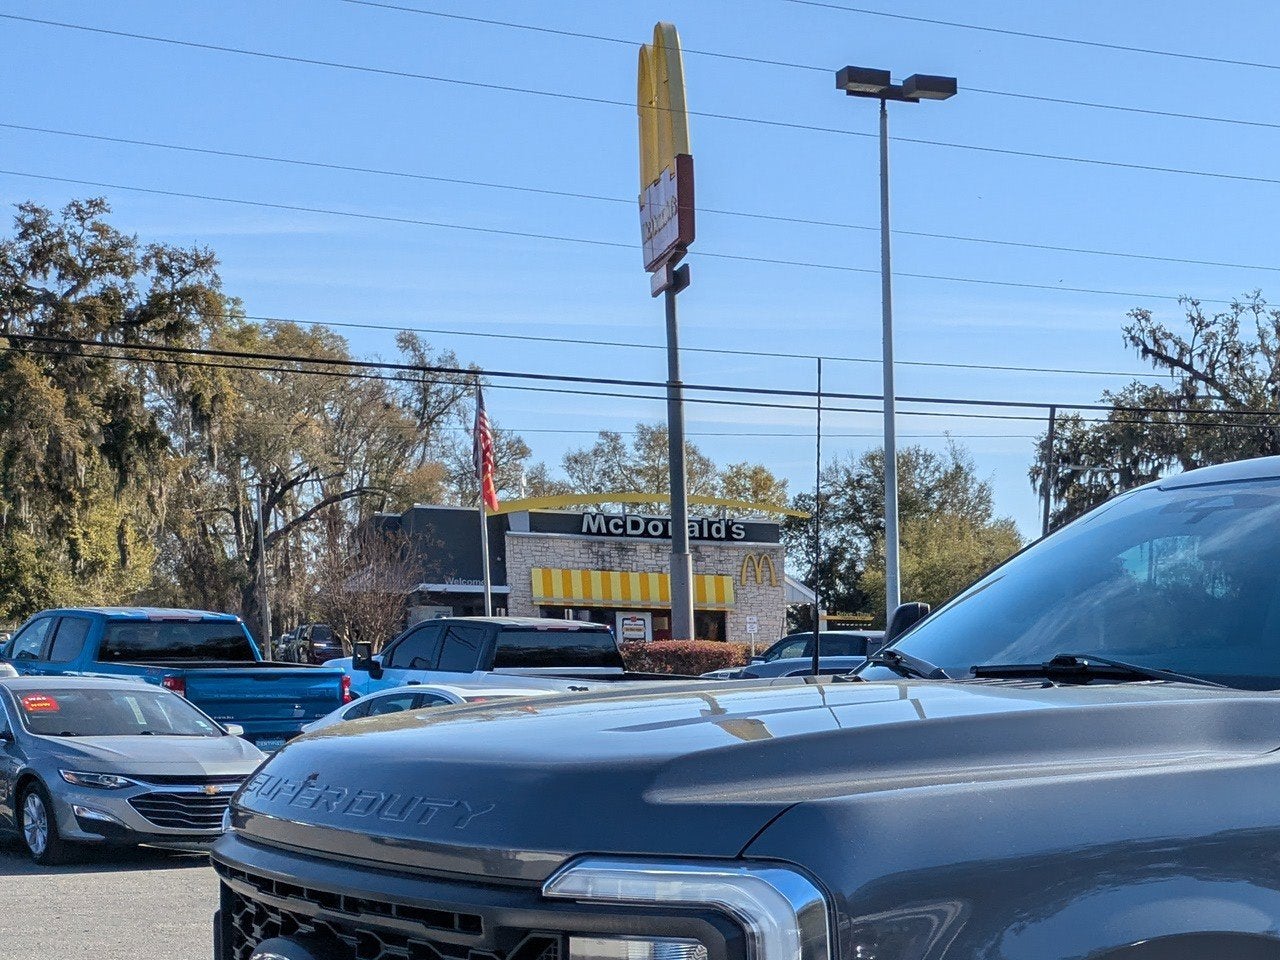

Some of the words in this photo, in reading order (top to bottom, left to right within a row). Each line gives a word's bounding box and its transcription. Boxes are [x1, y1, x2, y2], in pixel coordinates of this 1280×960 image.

[581, 513, 746, 540] McDoald's
[245, 772, 348, 814] SUPER
[344, 788, 496, 830] DUTY
